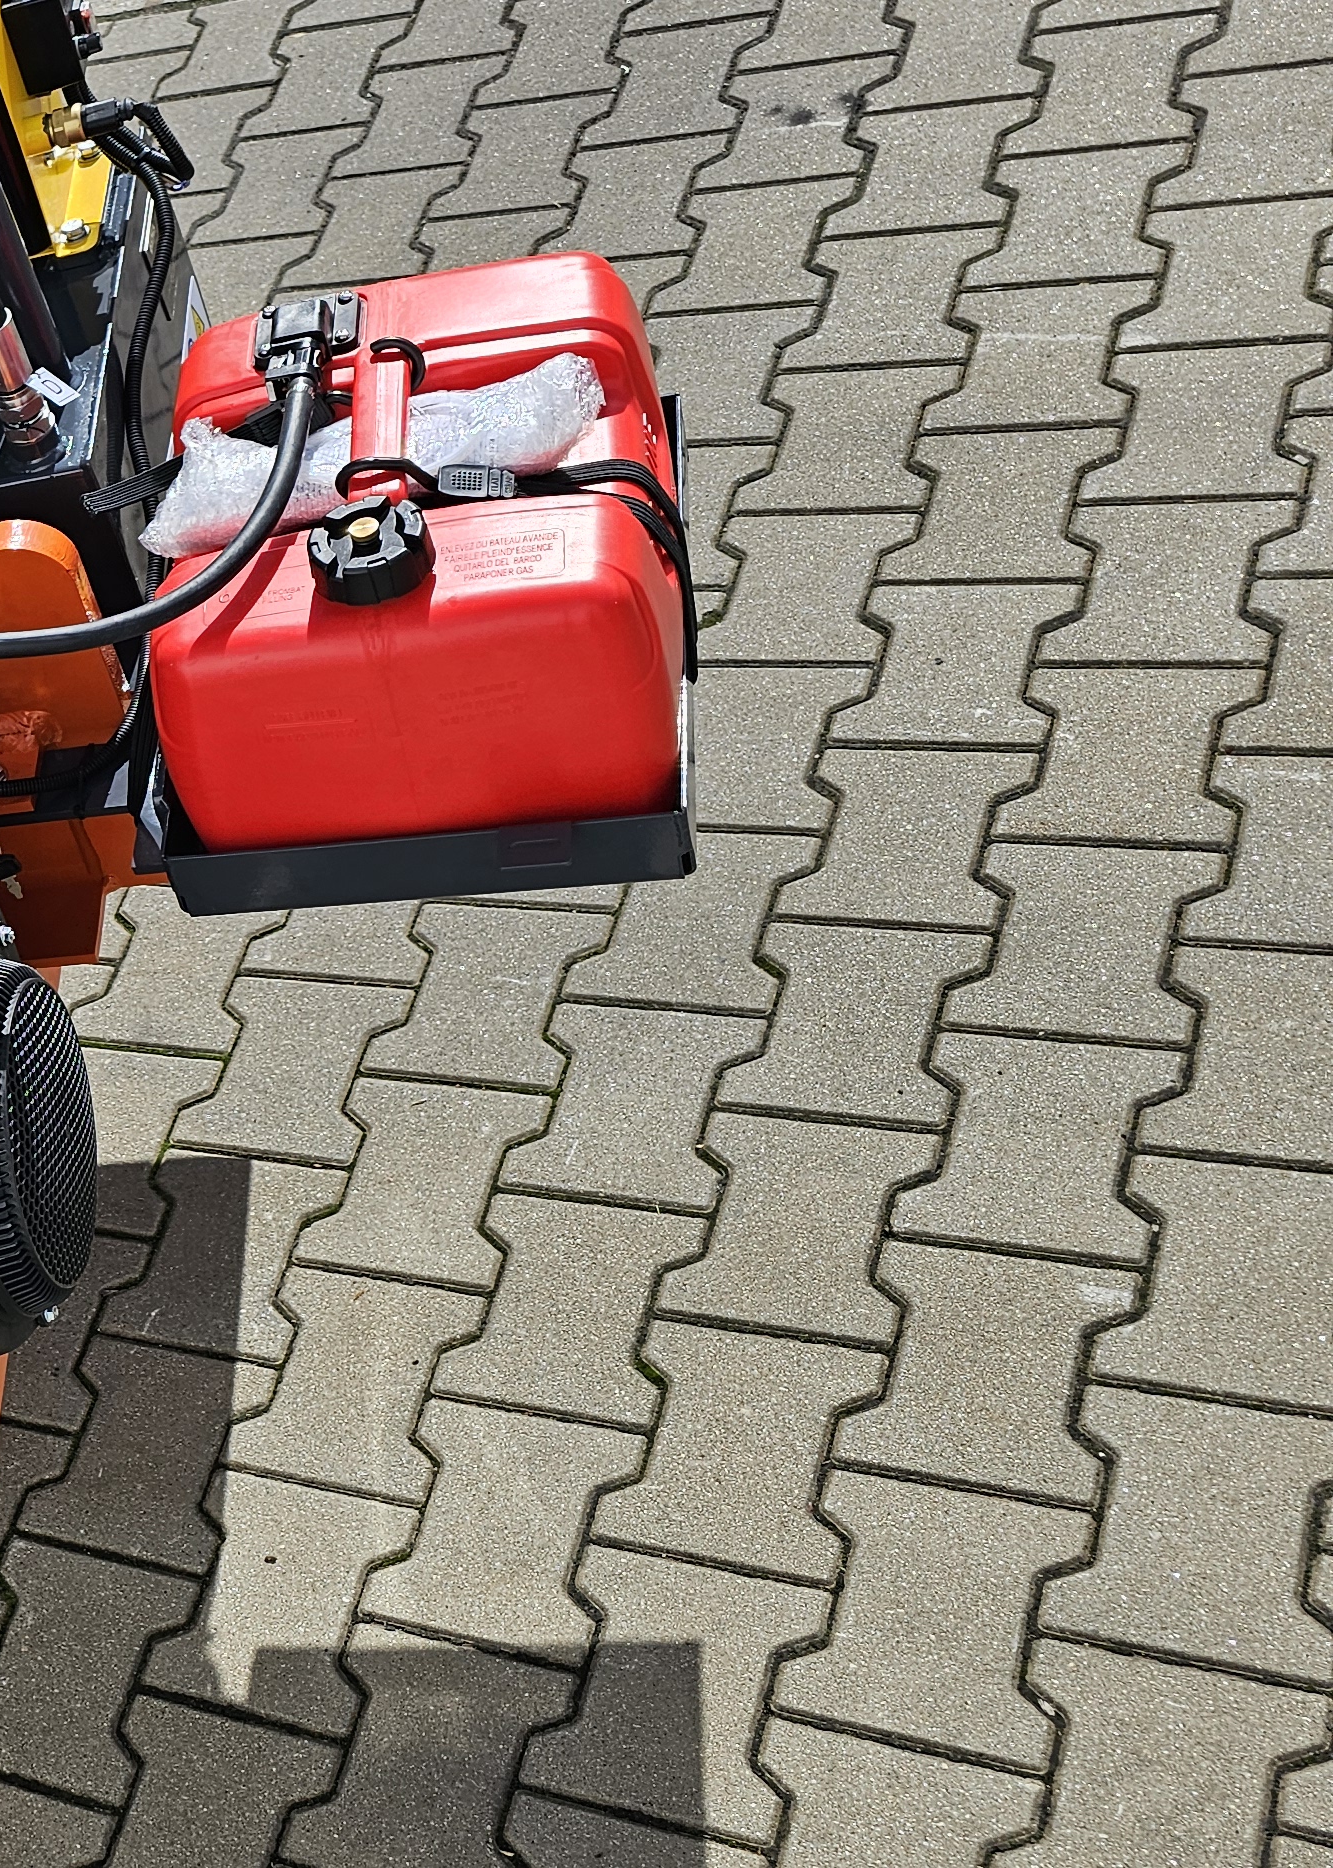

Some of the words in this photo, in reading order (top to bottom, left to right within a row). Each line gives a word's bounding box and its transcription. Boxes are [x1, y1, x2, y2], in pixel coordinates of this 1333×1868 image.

[41, 379, 63, 394] D
[489, 535, 520, 546] BATEAU
[516, 565, 533, 574] GAS
